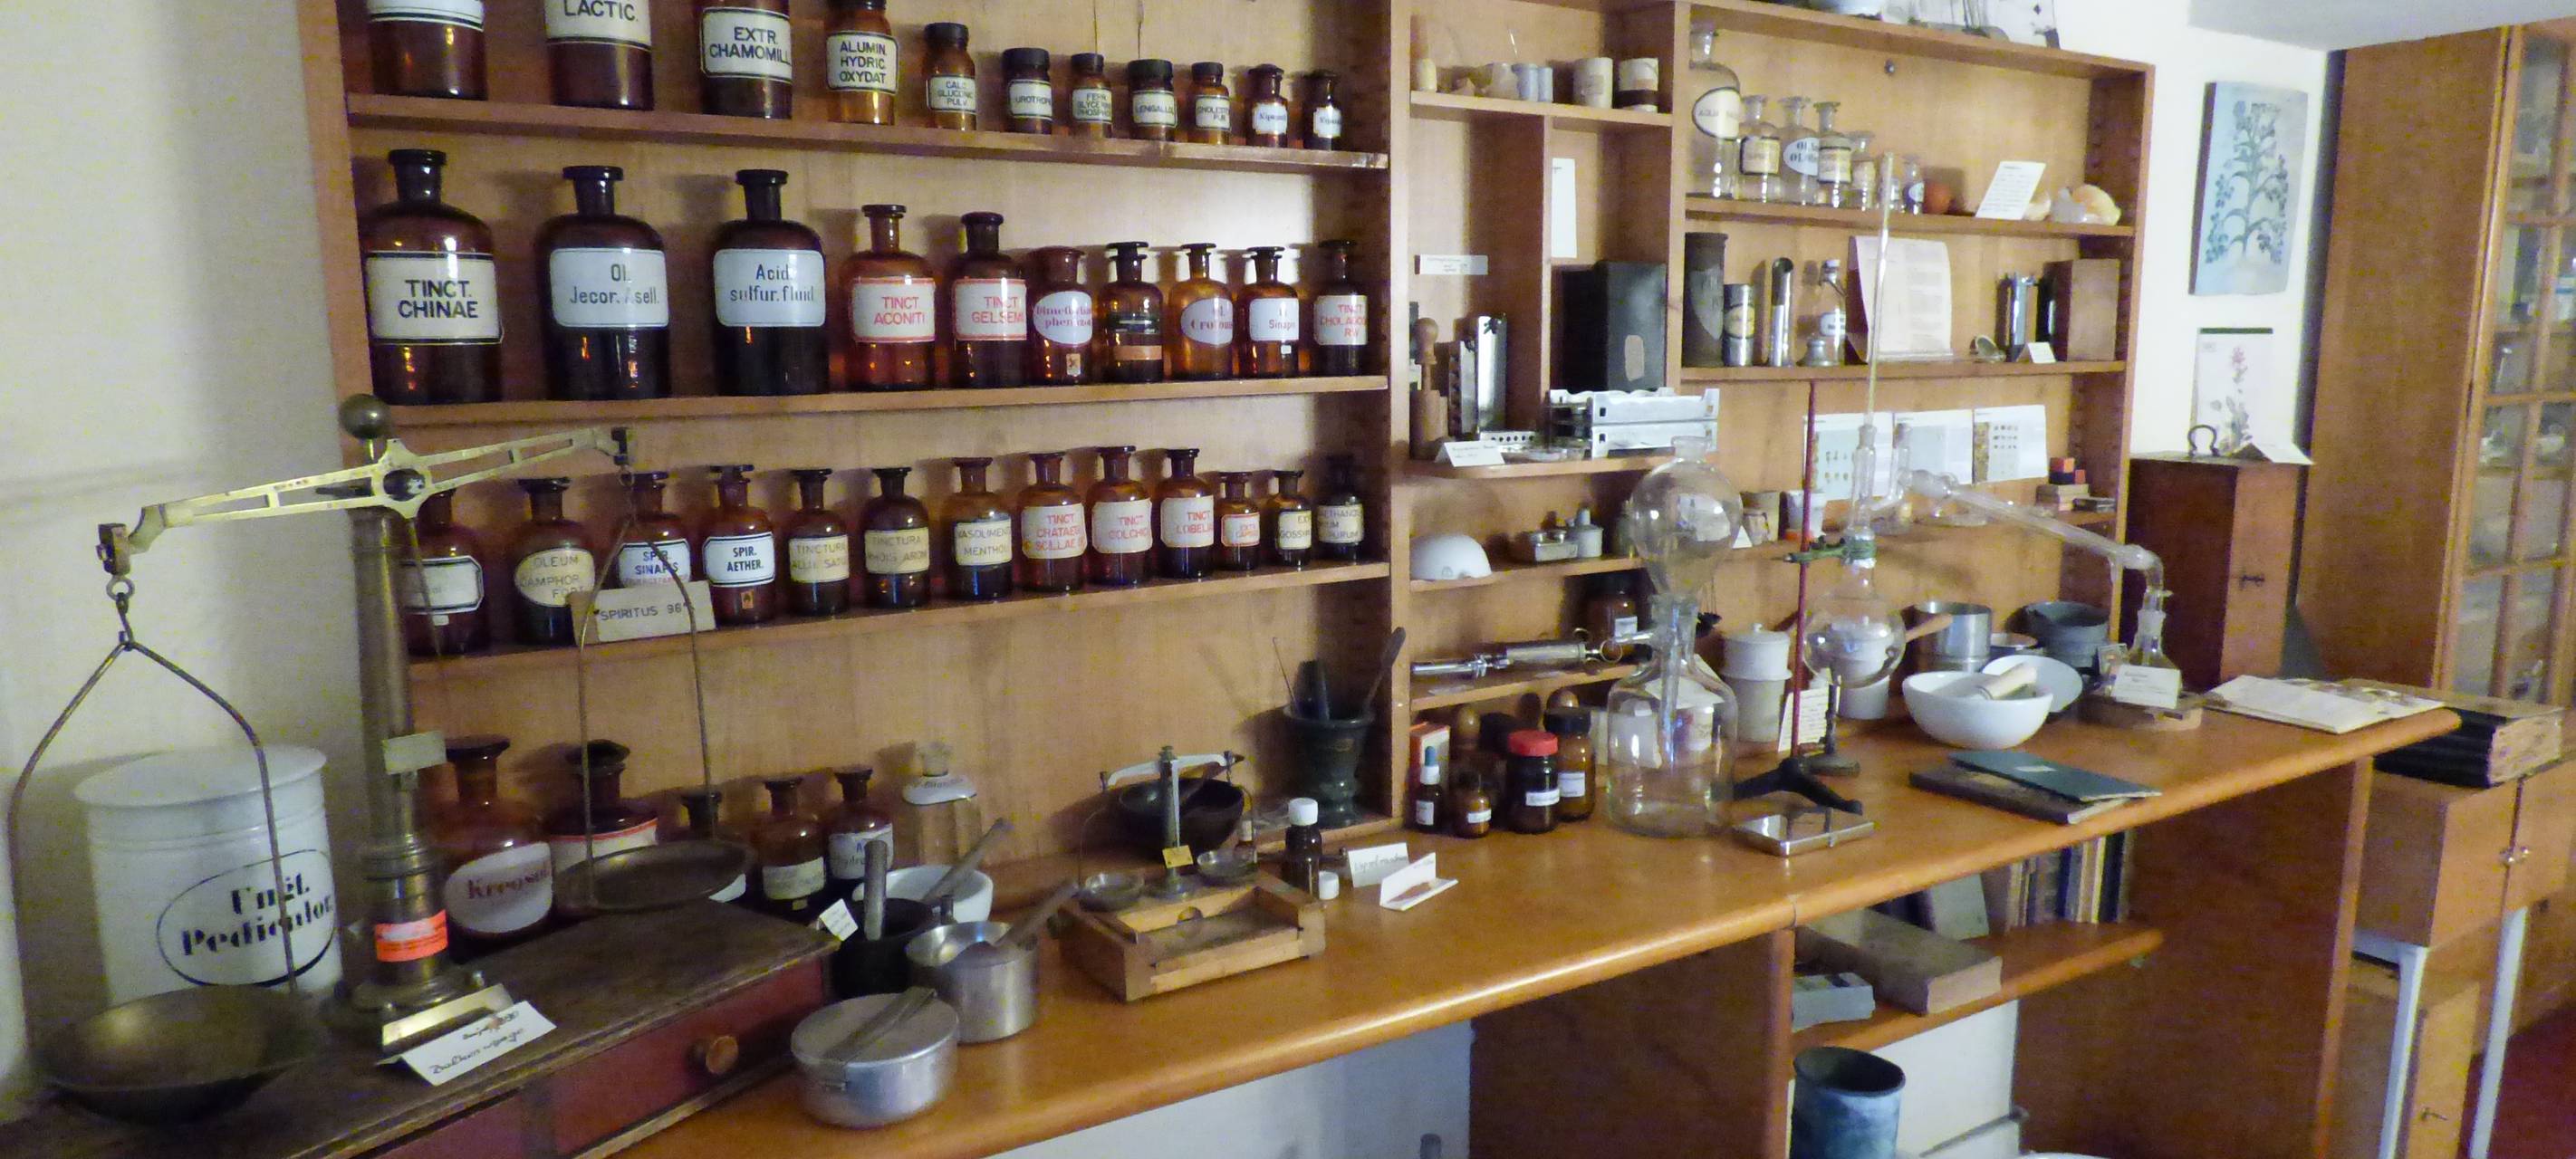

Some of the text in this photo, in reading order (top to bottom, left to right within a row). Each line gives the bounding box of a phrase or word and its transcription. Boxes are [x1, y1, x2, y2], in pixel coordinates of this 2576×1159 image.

[839, 70, 887, 84] OXYDAT
[397, 299, 480, 320] CHINAE
[881, 295, 920, 310] TINCT
[634, 561, 680, 576] SINAPS
[600, 606, 659, 622] SPIRITUS
